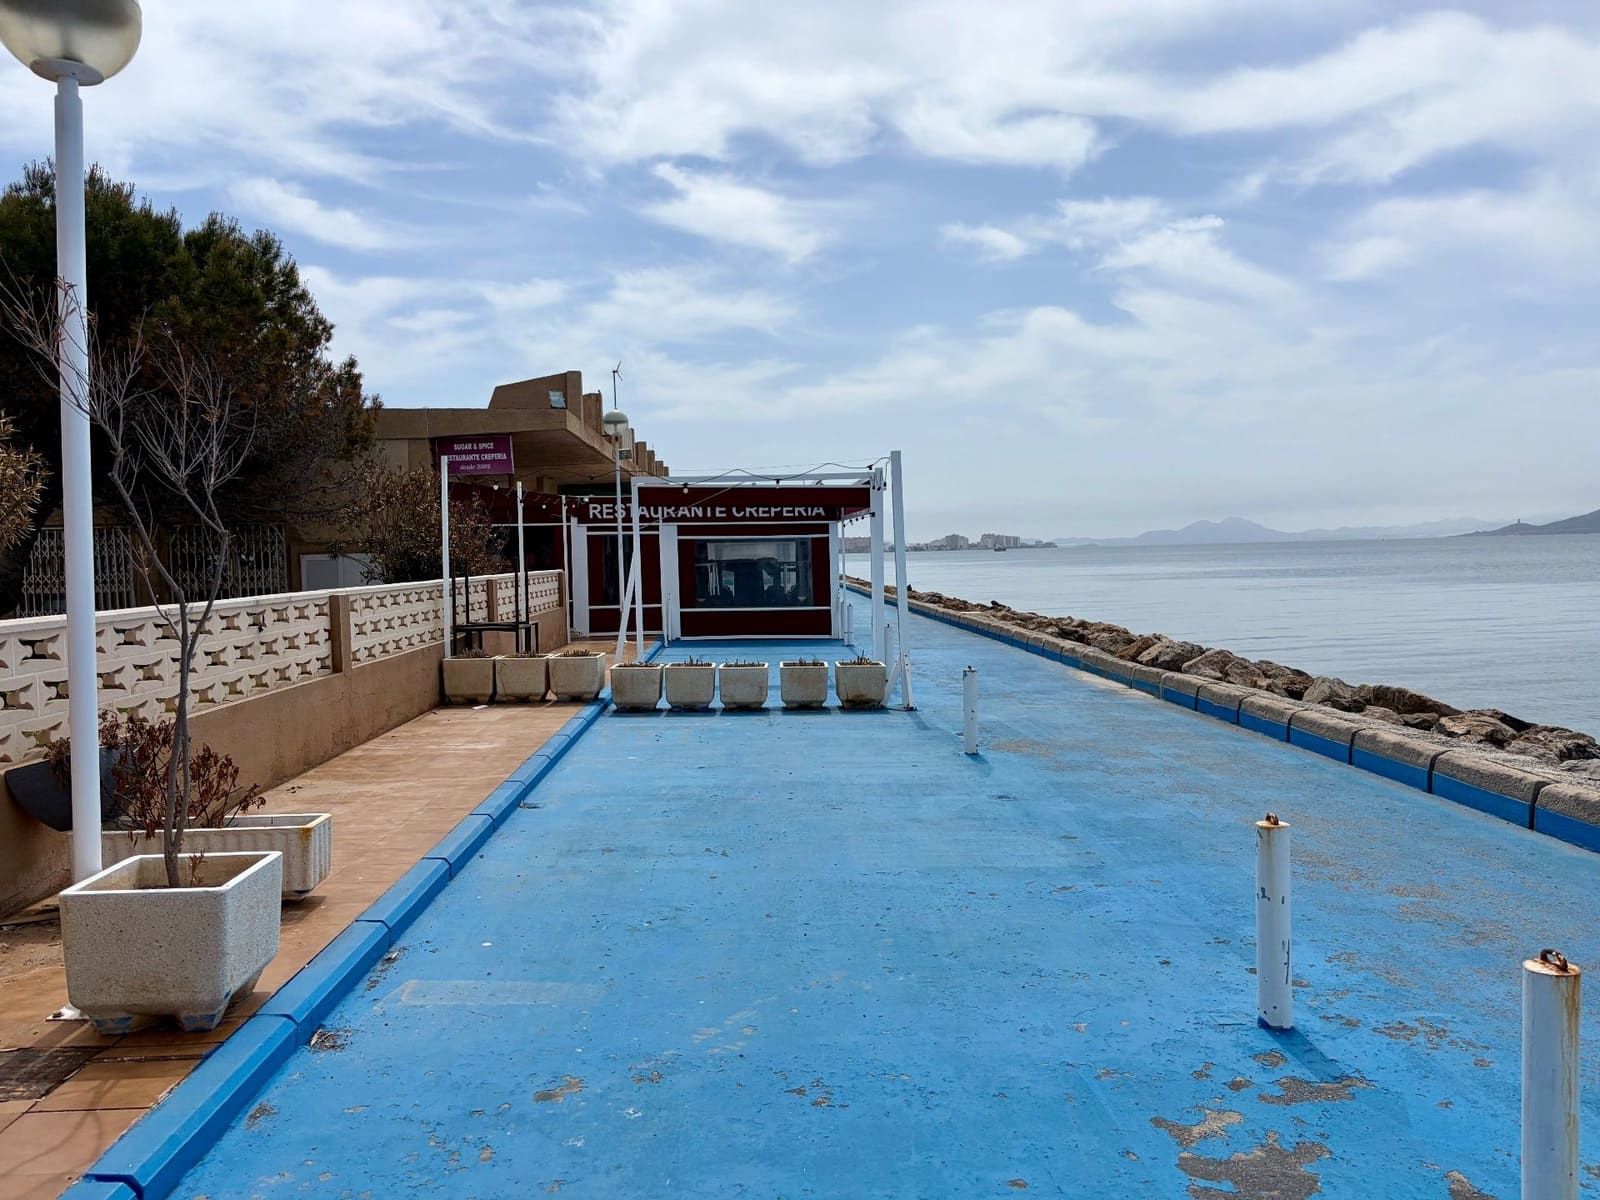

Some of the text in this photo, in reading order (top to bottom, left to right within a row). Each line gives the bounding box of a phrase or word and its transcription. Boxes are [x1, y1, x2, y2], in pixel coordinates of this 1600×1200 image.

[453, 443, 473, 451] SUGAR
[479, 442, 494, 450] SPICE
[446, 454, 480, 462] ESTAURANTE
